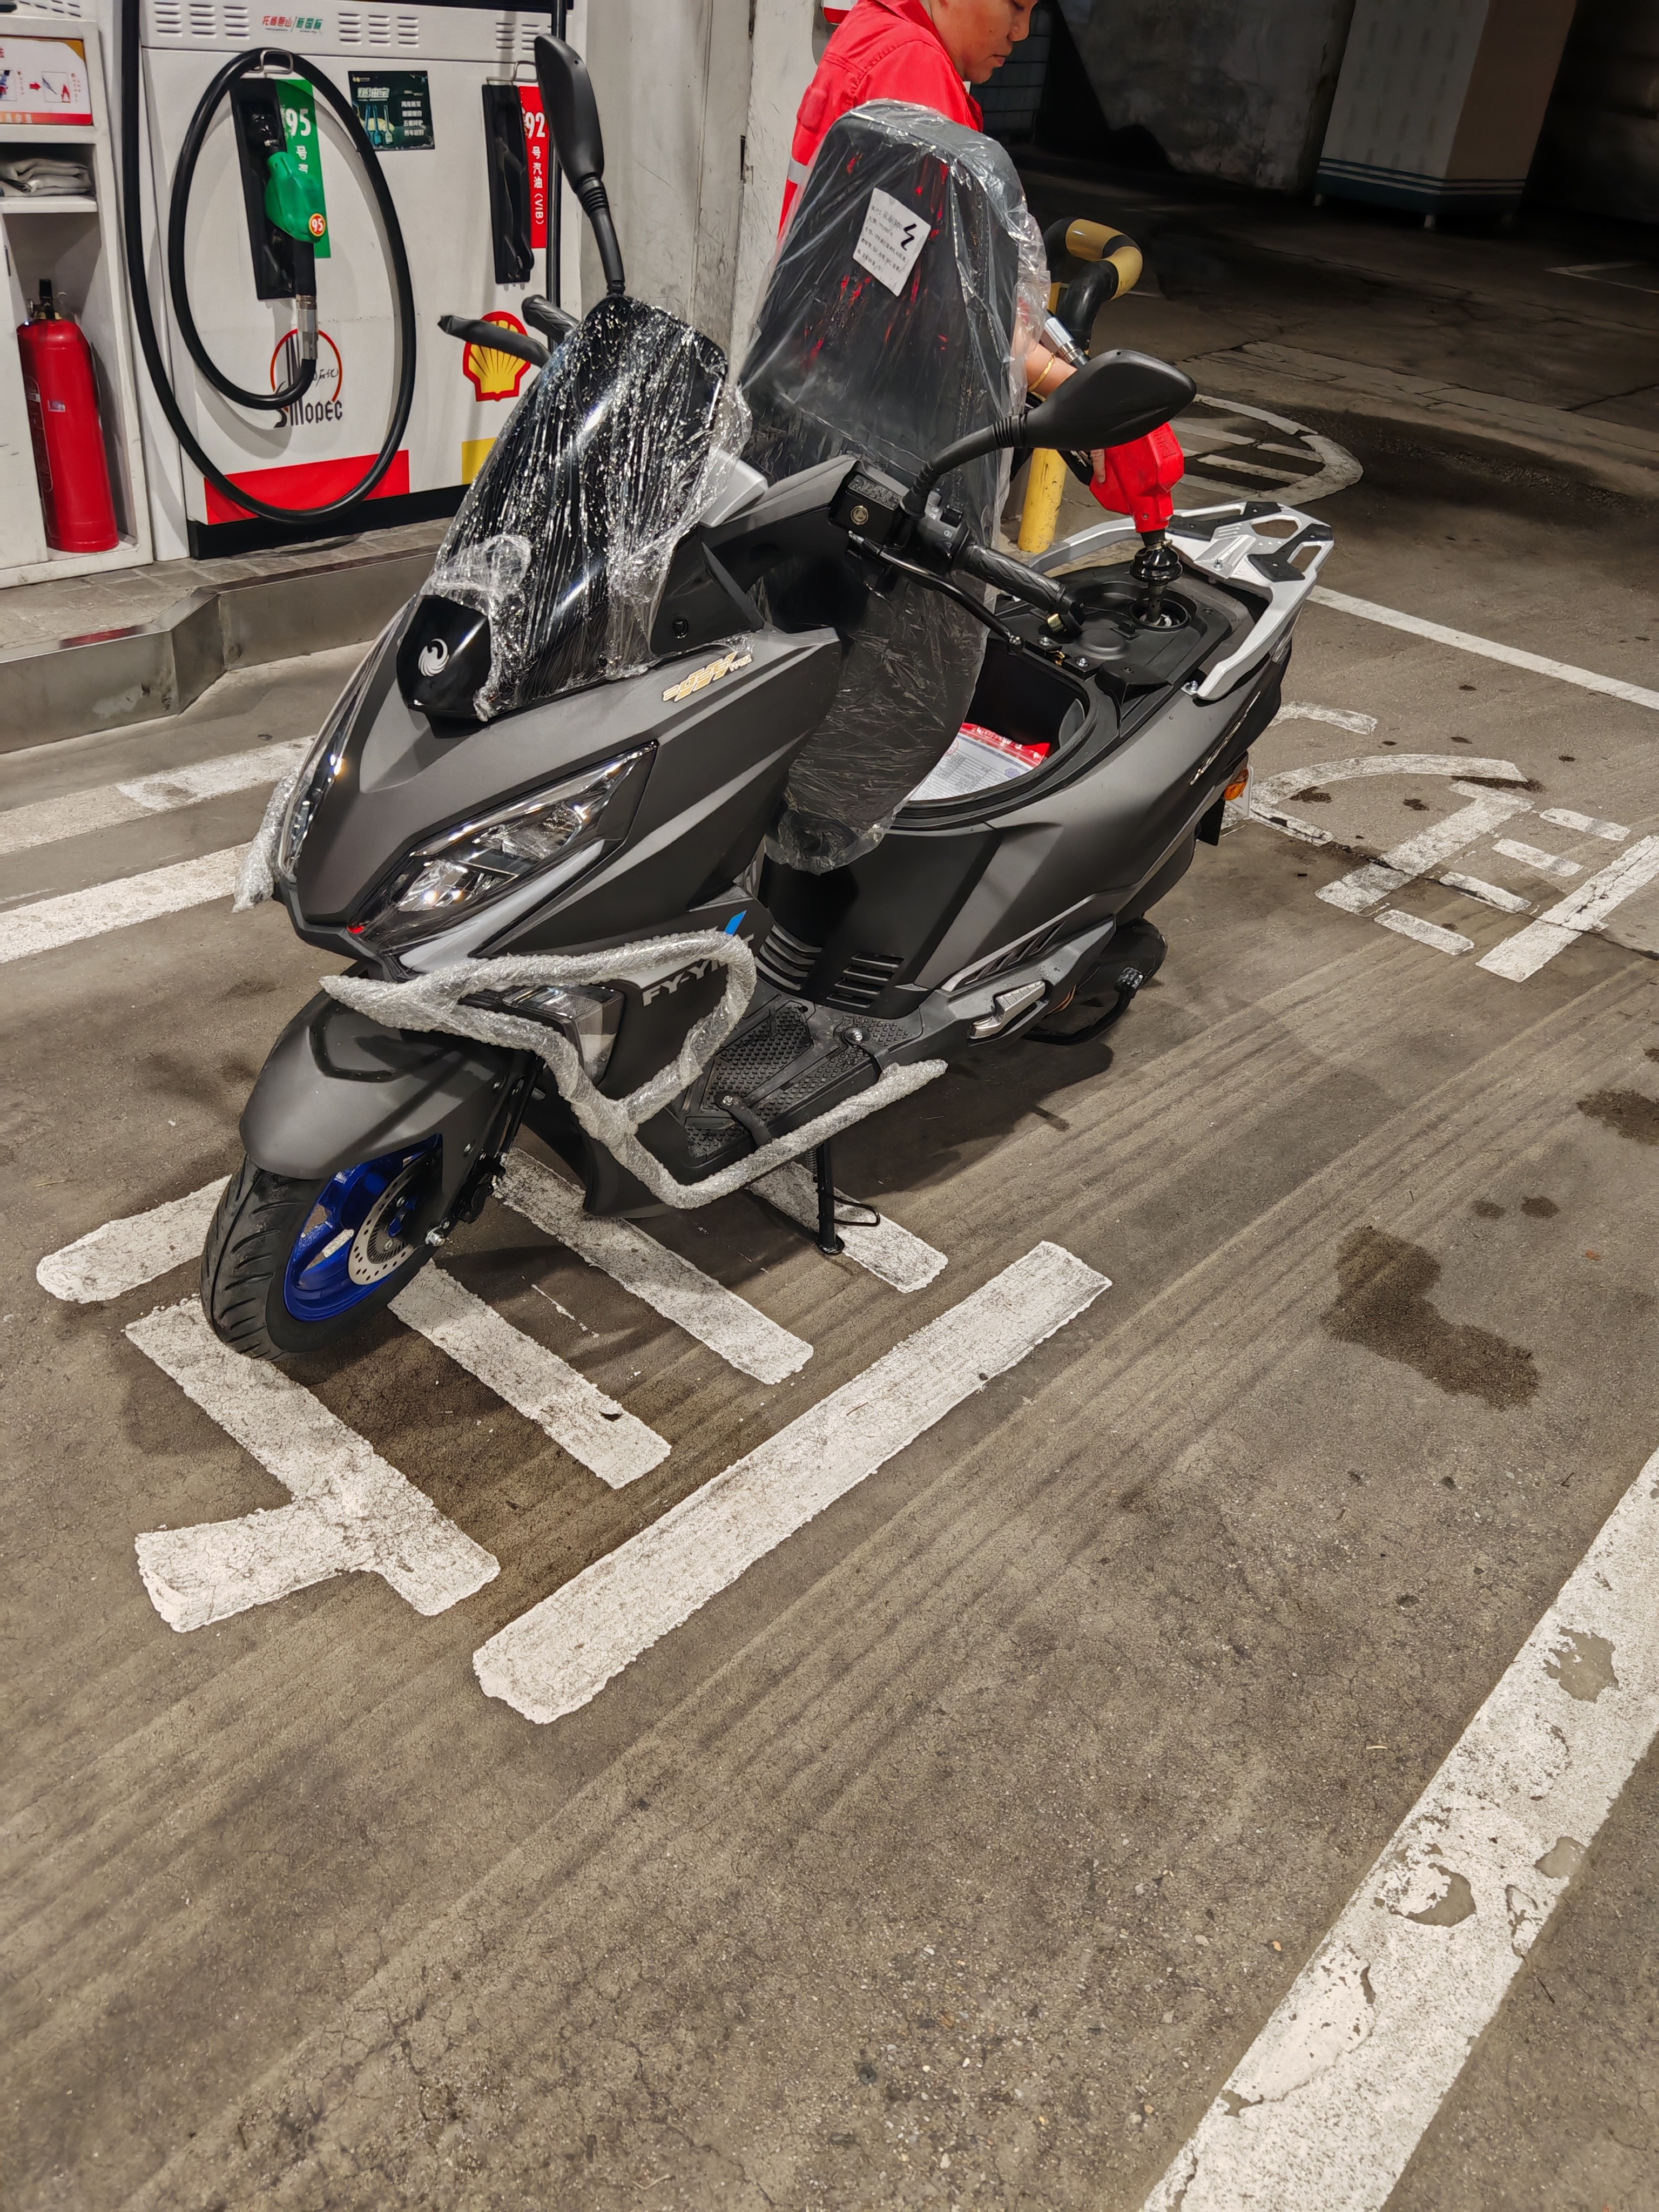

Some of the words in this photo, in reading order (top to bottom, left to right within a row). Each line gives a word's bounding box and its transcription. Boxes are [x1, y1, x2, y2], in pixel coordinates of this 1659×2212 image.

[285, 108, 312, 137] 95
[525, 112, 545, 139] 92
[311, 217, 323, 232] 95
